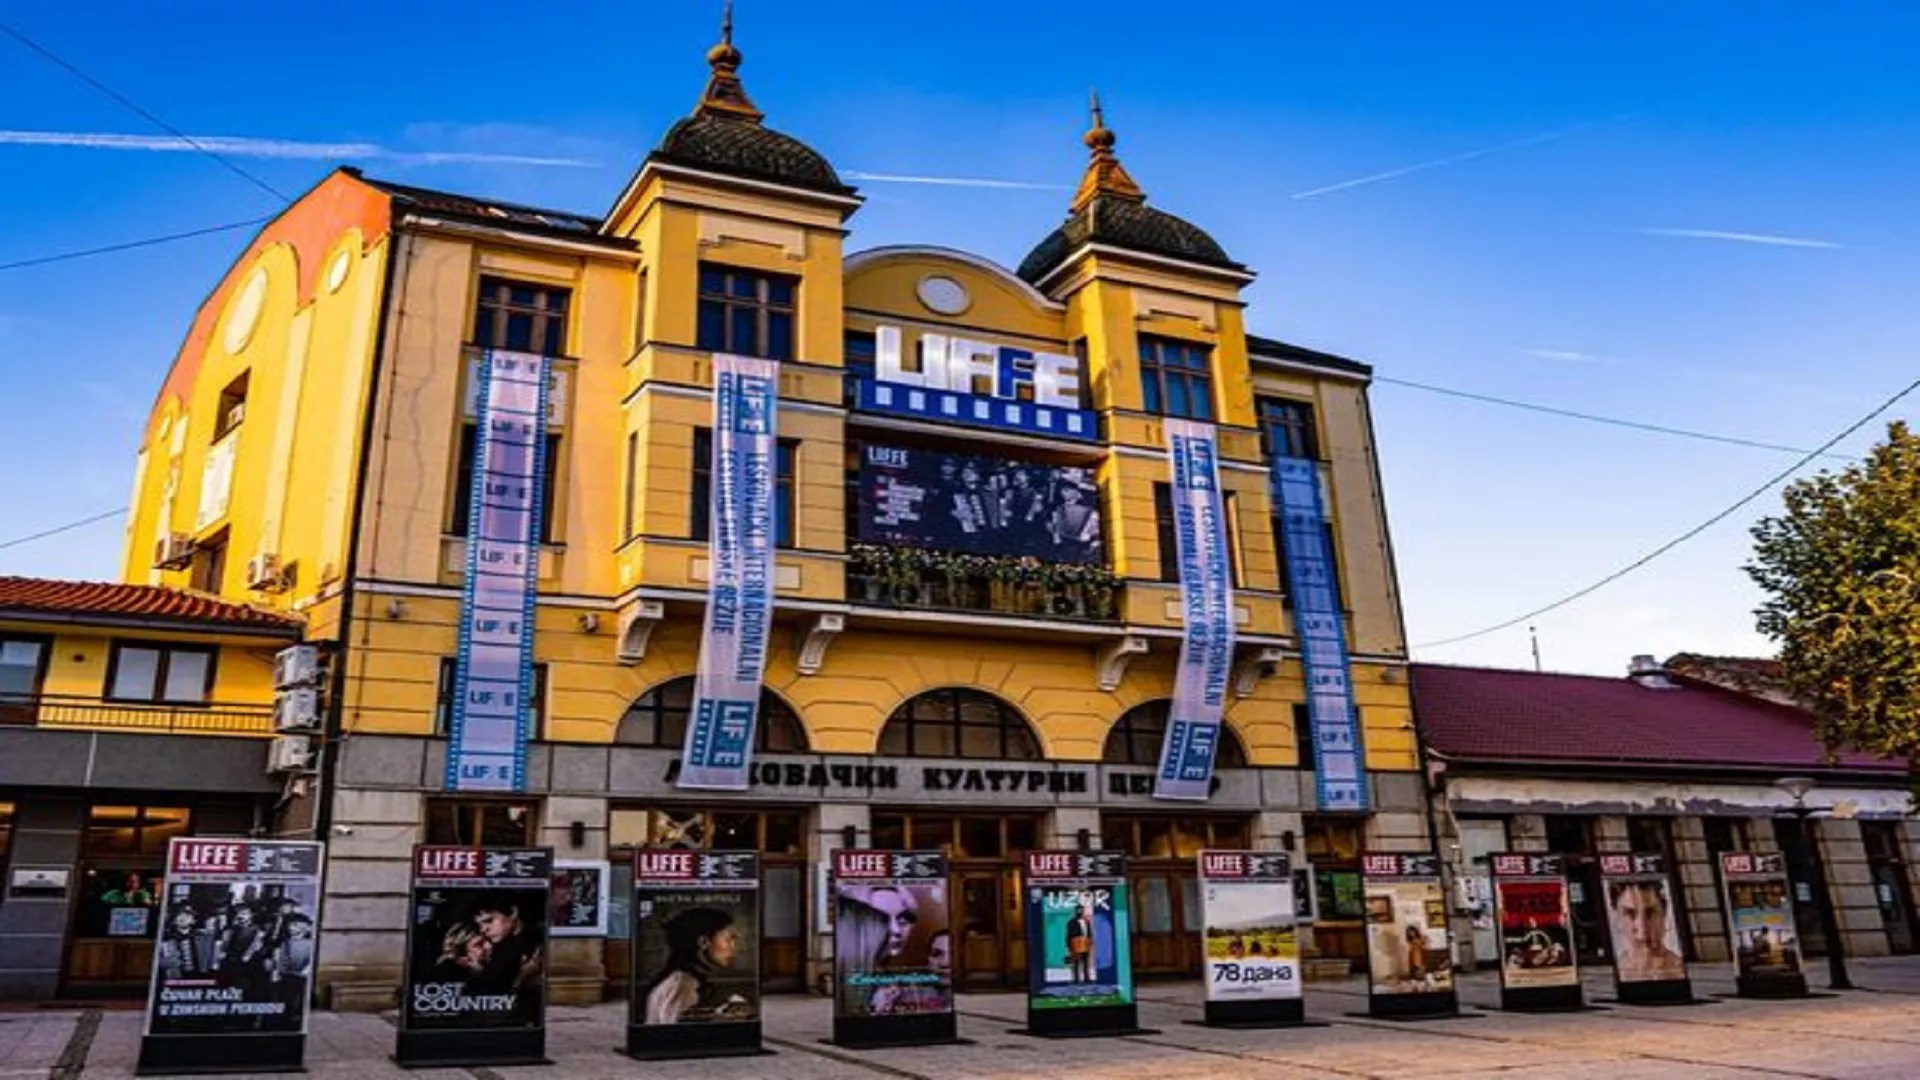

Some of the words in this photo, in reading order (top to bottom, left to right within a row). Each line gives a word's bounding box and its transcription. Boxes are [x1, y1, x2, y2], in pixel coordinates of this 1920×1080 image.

[875, 325, 1080, 409] LIFFE
[178, 844, 240, 865] LIFFE
[423, 851, 477, 869] LIFFE
[641, 854, 692, 871] LIFFE
[840, 854, 886, 871] LIFFE
[1030, 854, 1070, 870] LIFFE
[1047, 889, 1110, 910] UZOR
[1213, 964, 1240, 982] 78
[1241, 966, 1292, 983] дана
[413, 982, 466, 997] LOST
[414, 995, 517, 1012] COUNTRY
